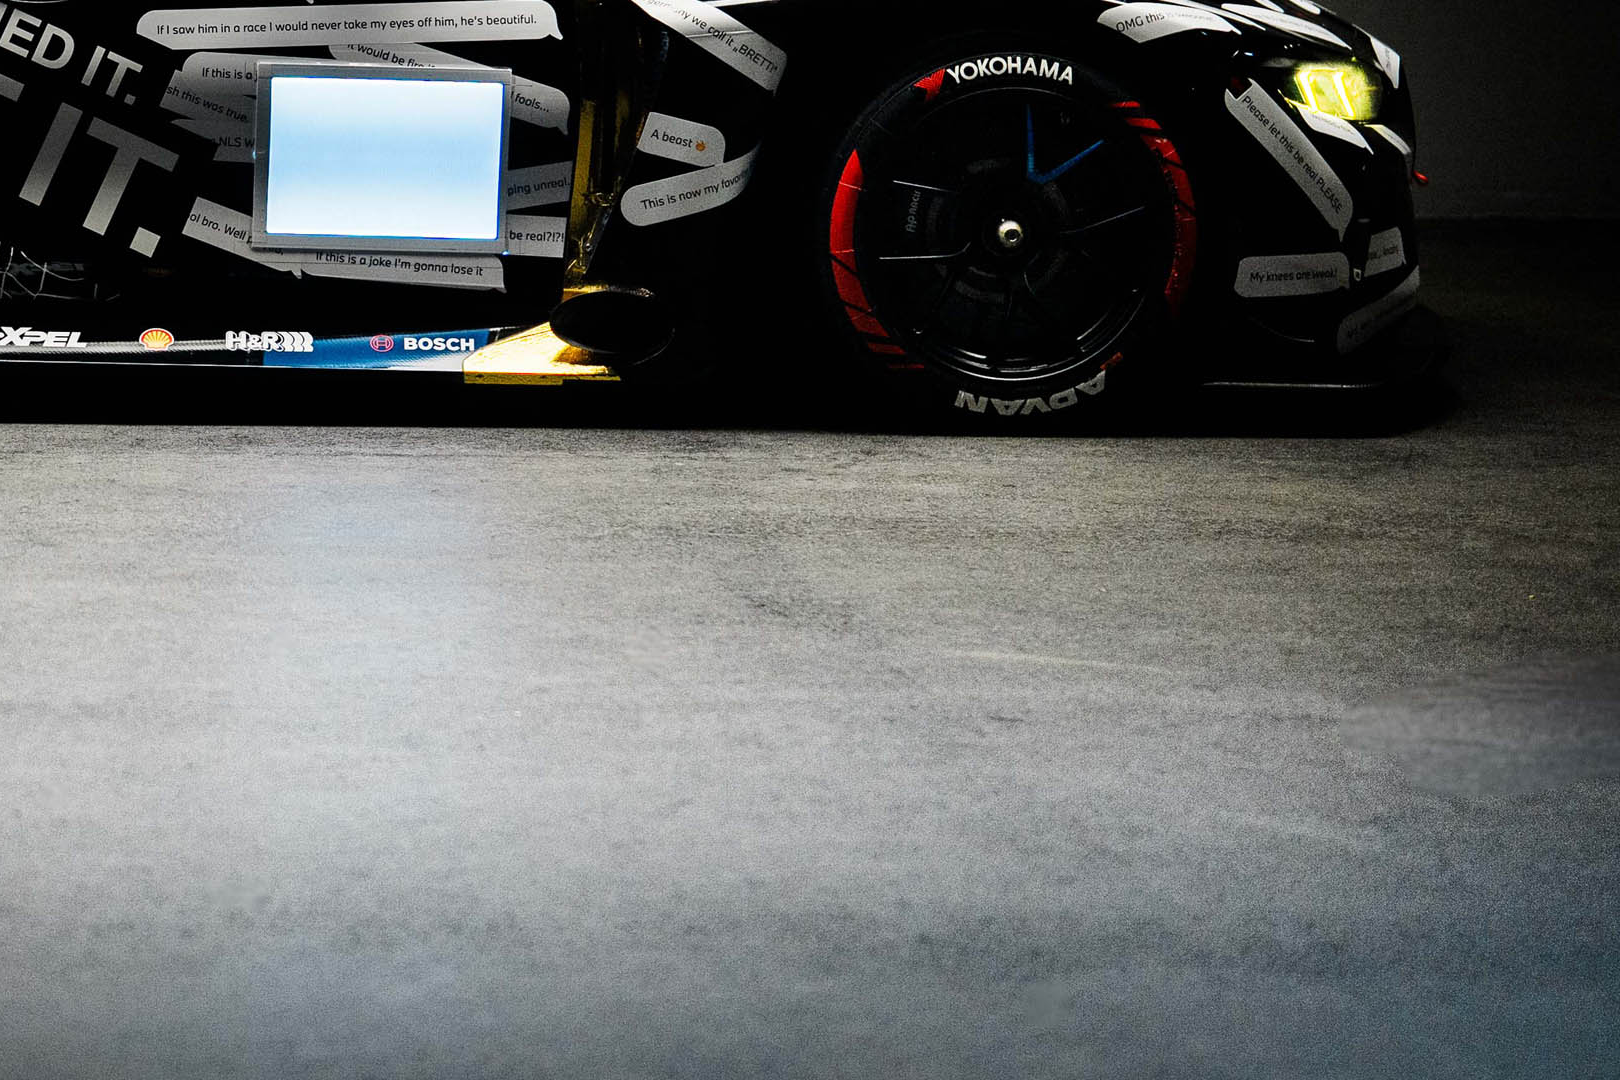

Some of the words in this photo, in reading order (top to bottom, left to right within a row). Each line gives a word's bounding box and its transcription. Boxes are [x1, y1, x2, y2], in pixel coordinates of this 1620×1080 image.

[157, 24, 165, 35] If
[173, 26, 195, 35] saw
[198, 23, 218, 34] him
[221, 23, 231, 33] in
[233, 25, 240, 33] a
[243, 24, 267, 33] race
[275, 21, 308, 32] would
[312, 21, 341, 31] never
[343, 18, 368, 30] take
[370, 20, 386, 31] my
[389, 19, 414, 31] eyes
[417, 17, 432, 27] off
[435, 16, 458, 29] him,
[460, 15, 483, 26] he's
[486, 14, 537, 26] beautiful.
[692, 15, 708, 29] we
[708, 26, 727, 42] call
[1116, 15, 1144, 33] OMG
[356, 44, 390, 61] would
[391, 53, 406, 66] be
[81, 45, 143, 106] IT.
[202, 67, 210, 78] If
[211, 68, 231, 79] this
[234, 69, 243, 80] is
[245, 71, 253, 80] a
[946, 55, 1076, 86] YOKOHAMA
[181, 90, 202, 105] this
[203, 99, 225, 113] was
[650, 129, 659, 140] A
[662, 131, 693, 148] beast
[1242, 95, 1270, 127] Please
[1269, 123, 1281, 138] let
[1279, 134, 1294, 153] this
[1293, 150, 1304, 163] be
[1302, 161, 1317, 181] real
[1316, 177, 1343, 214] PLEASE
[18, 102, 180, 259] IT.
[640, 198, 665, 210] This
[666, 194, 677, 205] is
[678, 189, 702, 201] now
[704, 182, 720, 195] my
[201, 216, 221, 232] bro.
[224, 224, 247, 241] Well
[509, 230, 523, 240] be
[325, 253, 345, 263] this
[348, 255, 357, 264] is
[359, 257, 367, 265] a
[367, 256, 392, 268] joke
[394, 259, 411, 269] I'm
[414, 261, 448, 273] gonna
[450, 263, 473, 276] lose
[475, 265, 483, 276] it
[1250, 272, 1264, 282] My
[403, 337, 475, 351] BOSCH
[953, 370, 1106, 417] ADVAN
